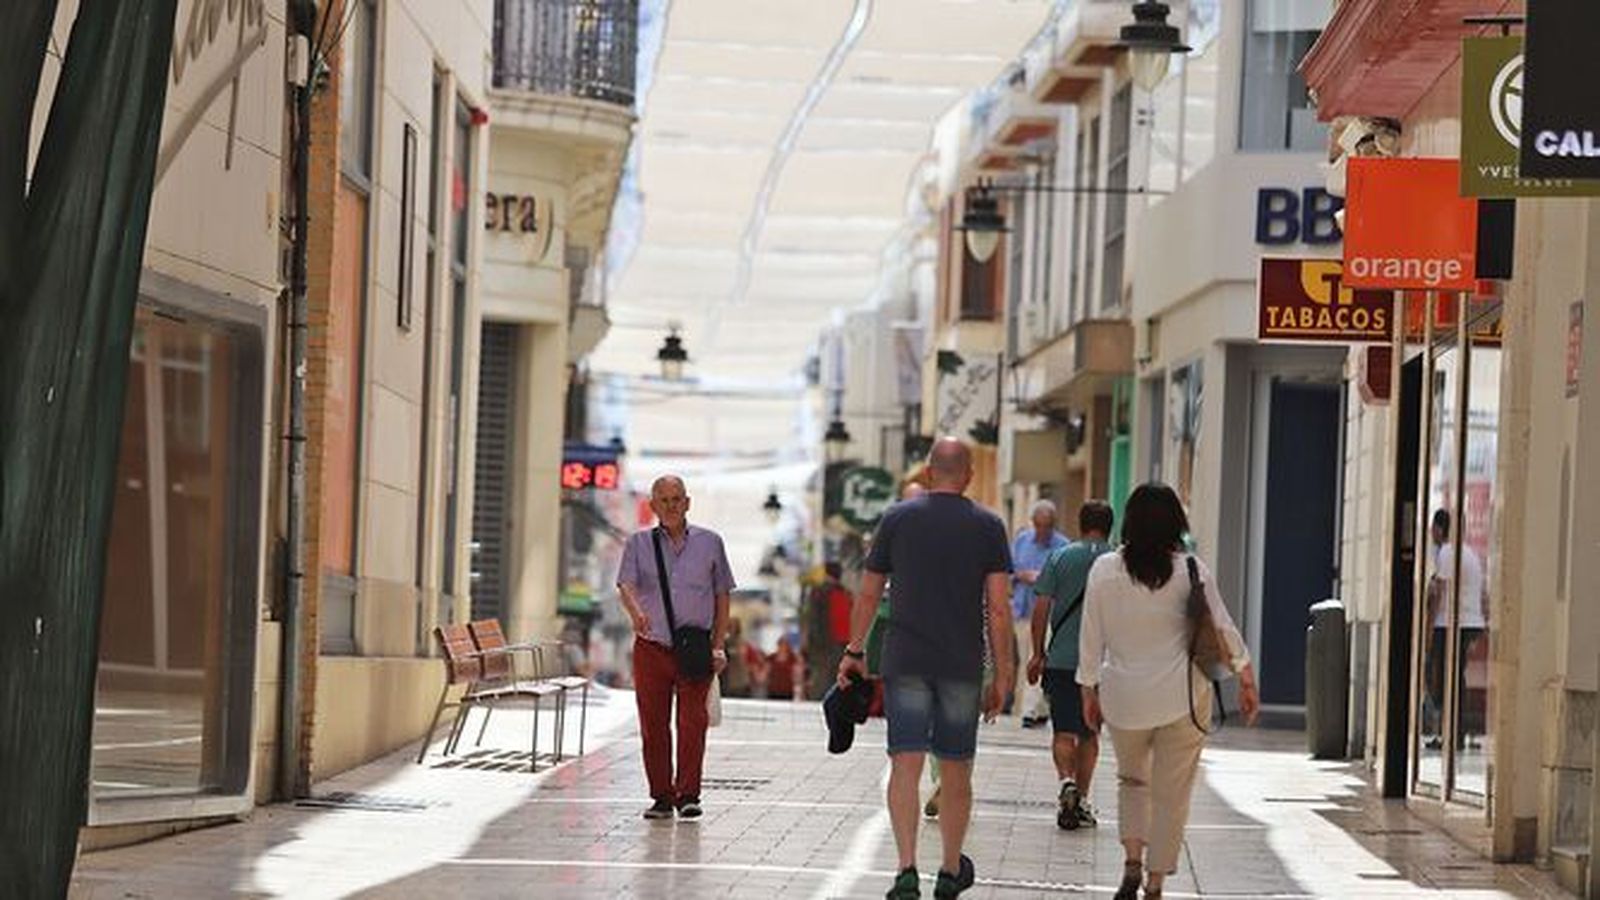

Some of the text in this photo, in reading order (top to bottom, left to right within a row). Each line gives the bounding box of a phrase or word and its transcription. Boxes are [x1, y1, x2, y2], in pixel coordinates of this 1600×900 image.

[1535, 130, 1600, 156] CAL
[1350, 257, 1462, 286] orange
[1266, 306, 1386, 329] TABACOS
